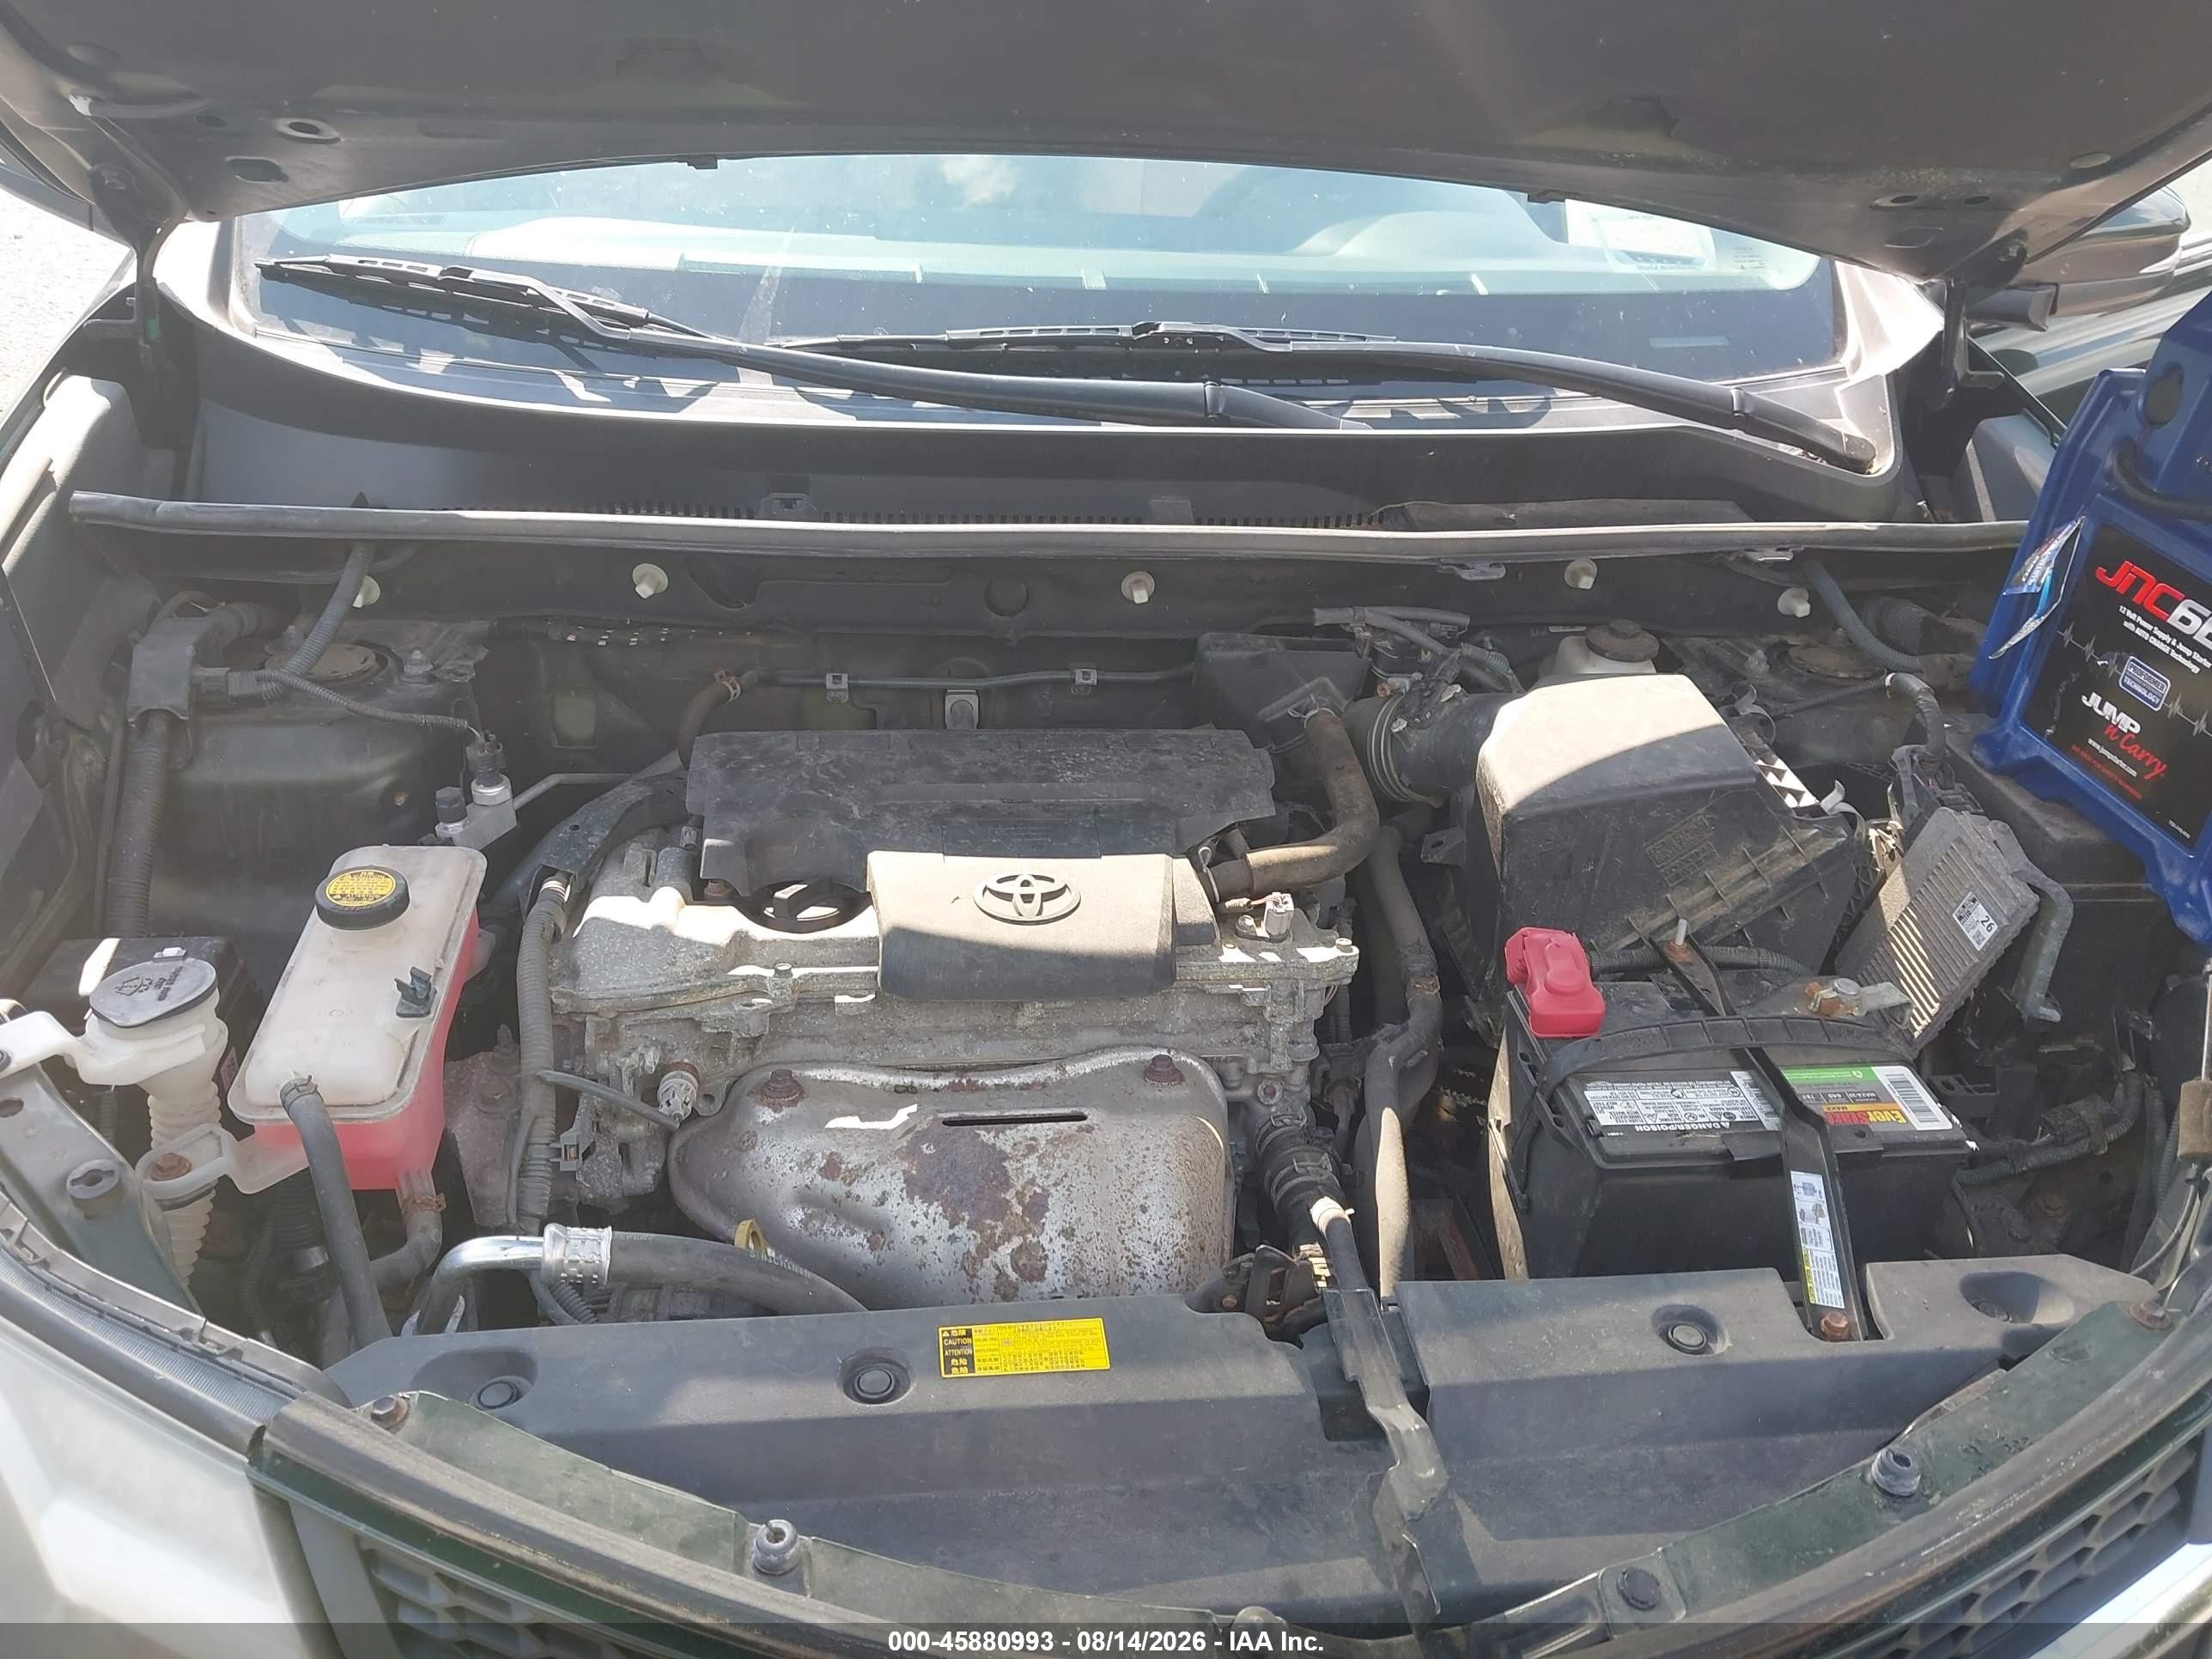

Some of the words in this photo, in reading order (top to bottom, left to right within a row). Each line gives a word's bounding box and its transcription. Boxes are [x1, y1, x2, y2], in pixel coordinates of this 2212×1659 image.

[2119, 605, 2127, 614] 12
[2126, 609, 2137, 621] Volt
[2136, 616, 2154, 630] Power
[2153, 627, 2172, 643] Supply
[2177, 642, 2192, 656] Jump
[2124, 621, 2136, 632] with
[2136, 628, 2149, 640] AUTO
[2149, 636, 2171, 653] CHARGE
[2170, 648, 2200, 673] Technology
[2124, 676, 2160, 703] TECHNOLOGY
[2129, 663, 2165, 692] PROFORMER
[2081, 692, 2141, 733] JUMP
[1981, 915, 1995, 933] 26
[1634, 1122, 1721, 1132] DANGER/POISON
[1826, 1110, 1906, 1126] EverStart
